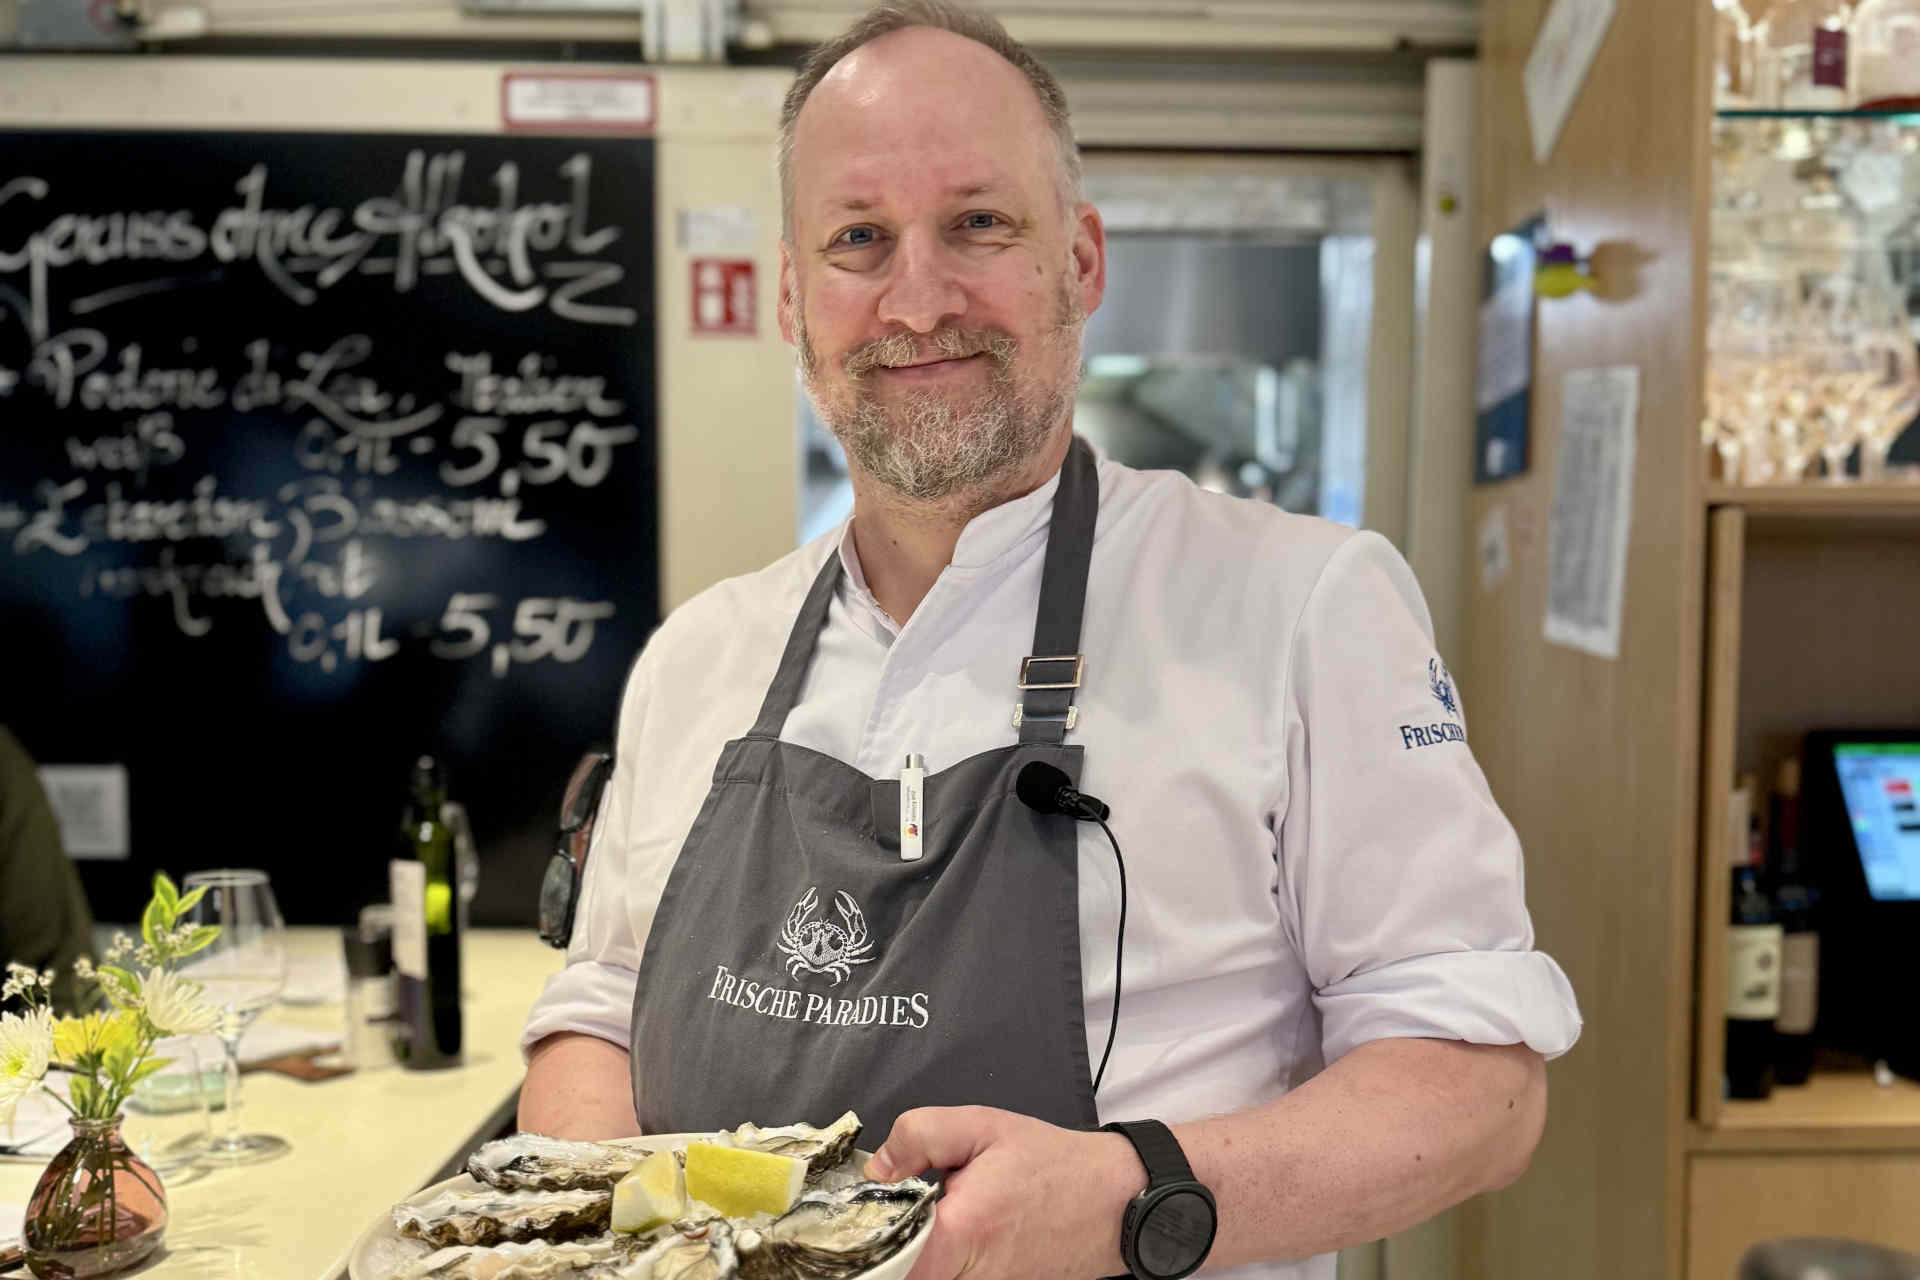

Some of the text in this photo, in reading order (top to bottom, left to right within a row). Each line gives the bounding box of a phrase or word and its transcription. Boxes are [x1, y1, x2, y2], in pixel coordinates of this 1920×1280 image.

[211, 163, 372, 306] ohne
[354, 149, 623, 312] Alkohol
[440, 417, 639, 496] 5,50
[429, 591, 616, 678] 5,50
[707, 964, 929, 1029] FRISCHE PARADIES
